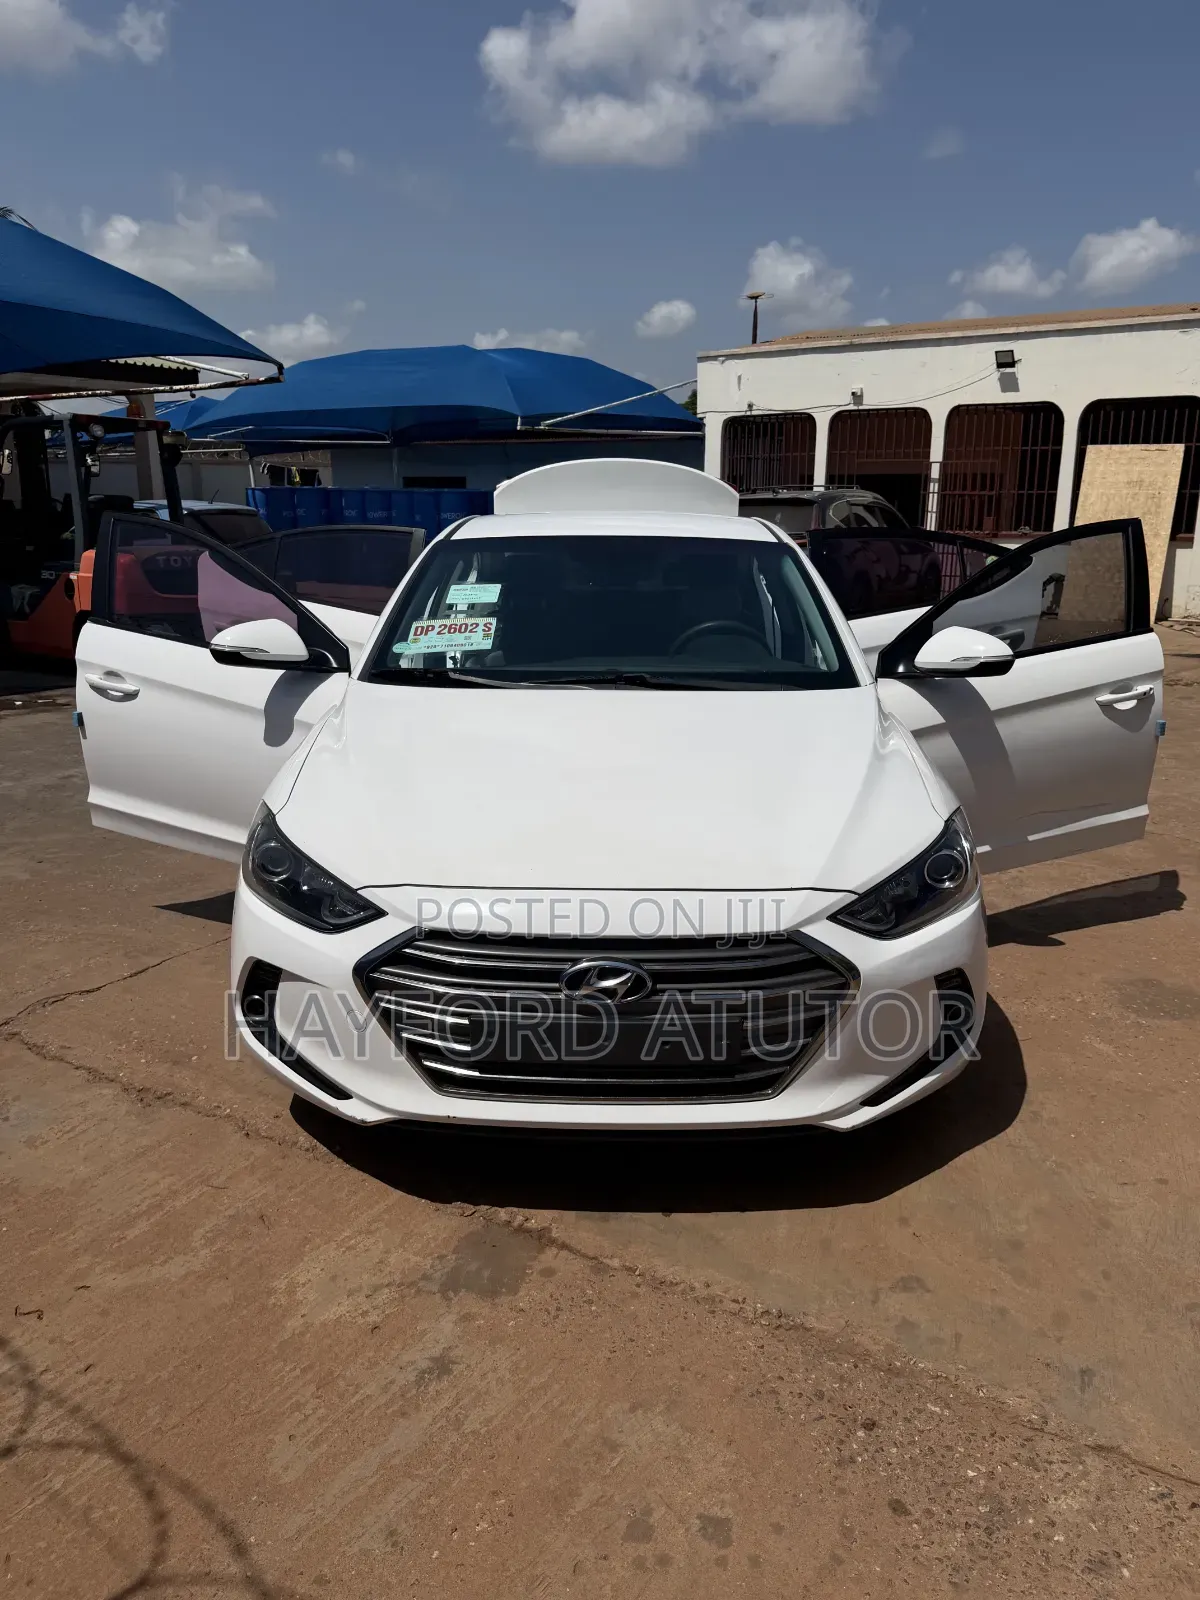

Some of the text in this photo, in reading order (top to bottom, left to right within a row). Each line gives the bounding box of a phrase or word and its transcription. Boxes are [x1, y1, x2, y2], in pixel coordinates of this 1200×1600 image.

[155, 555, 193, 568] TOY
[413, 621, 493, 637] DP 2602 S
